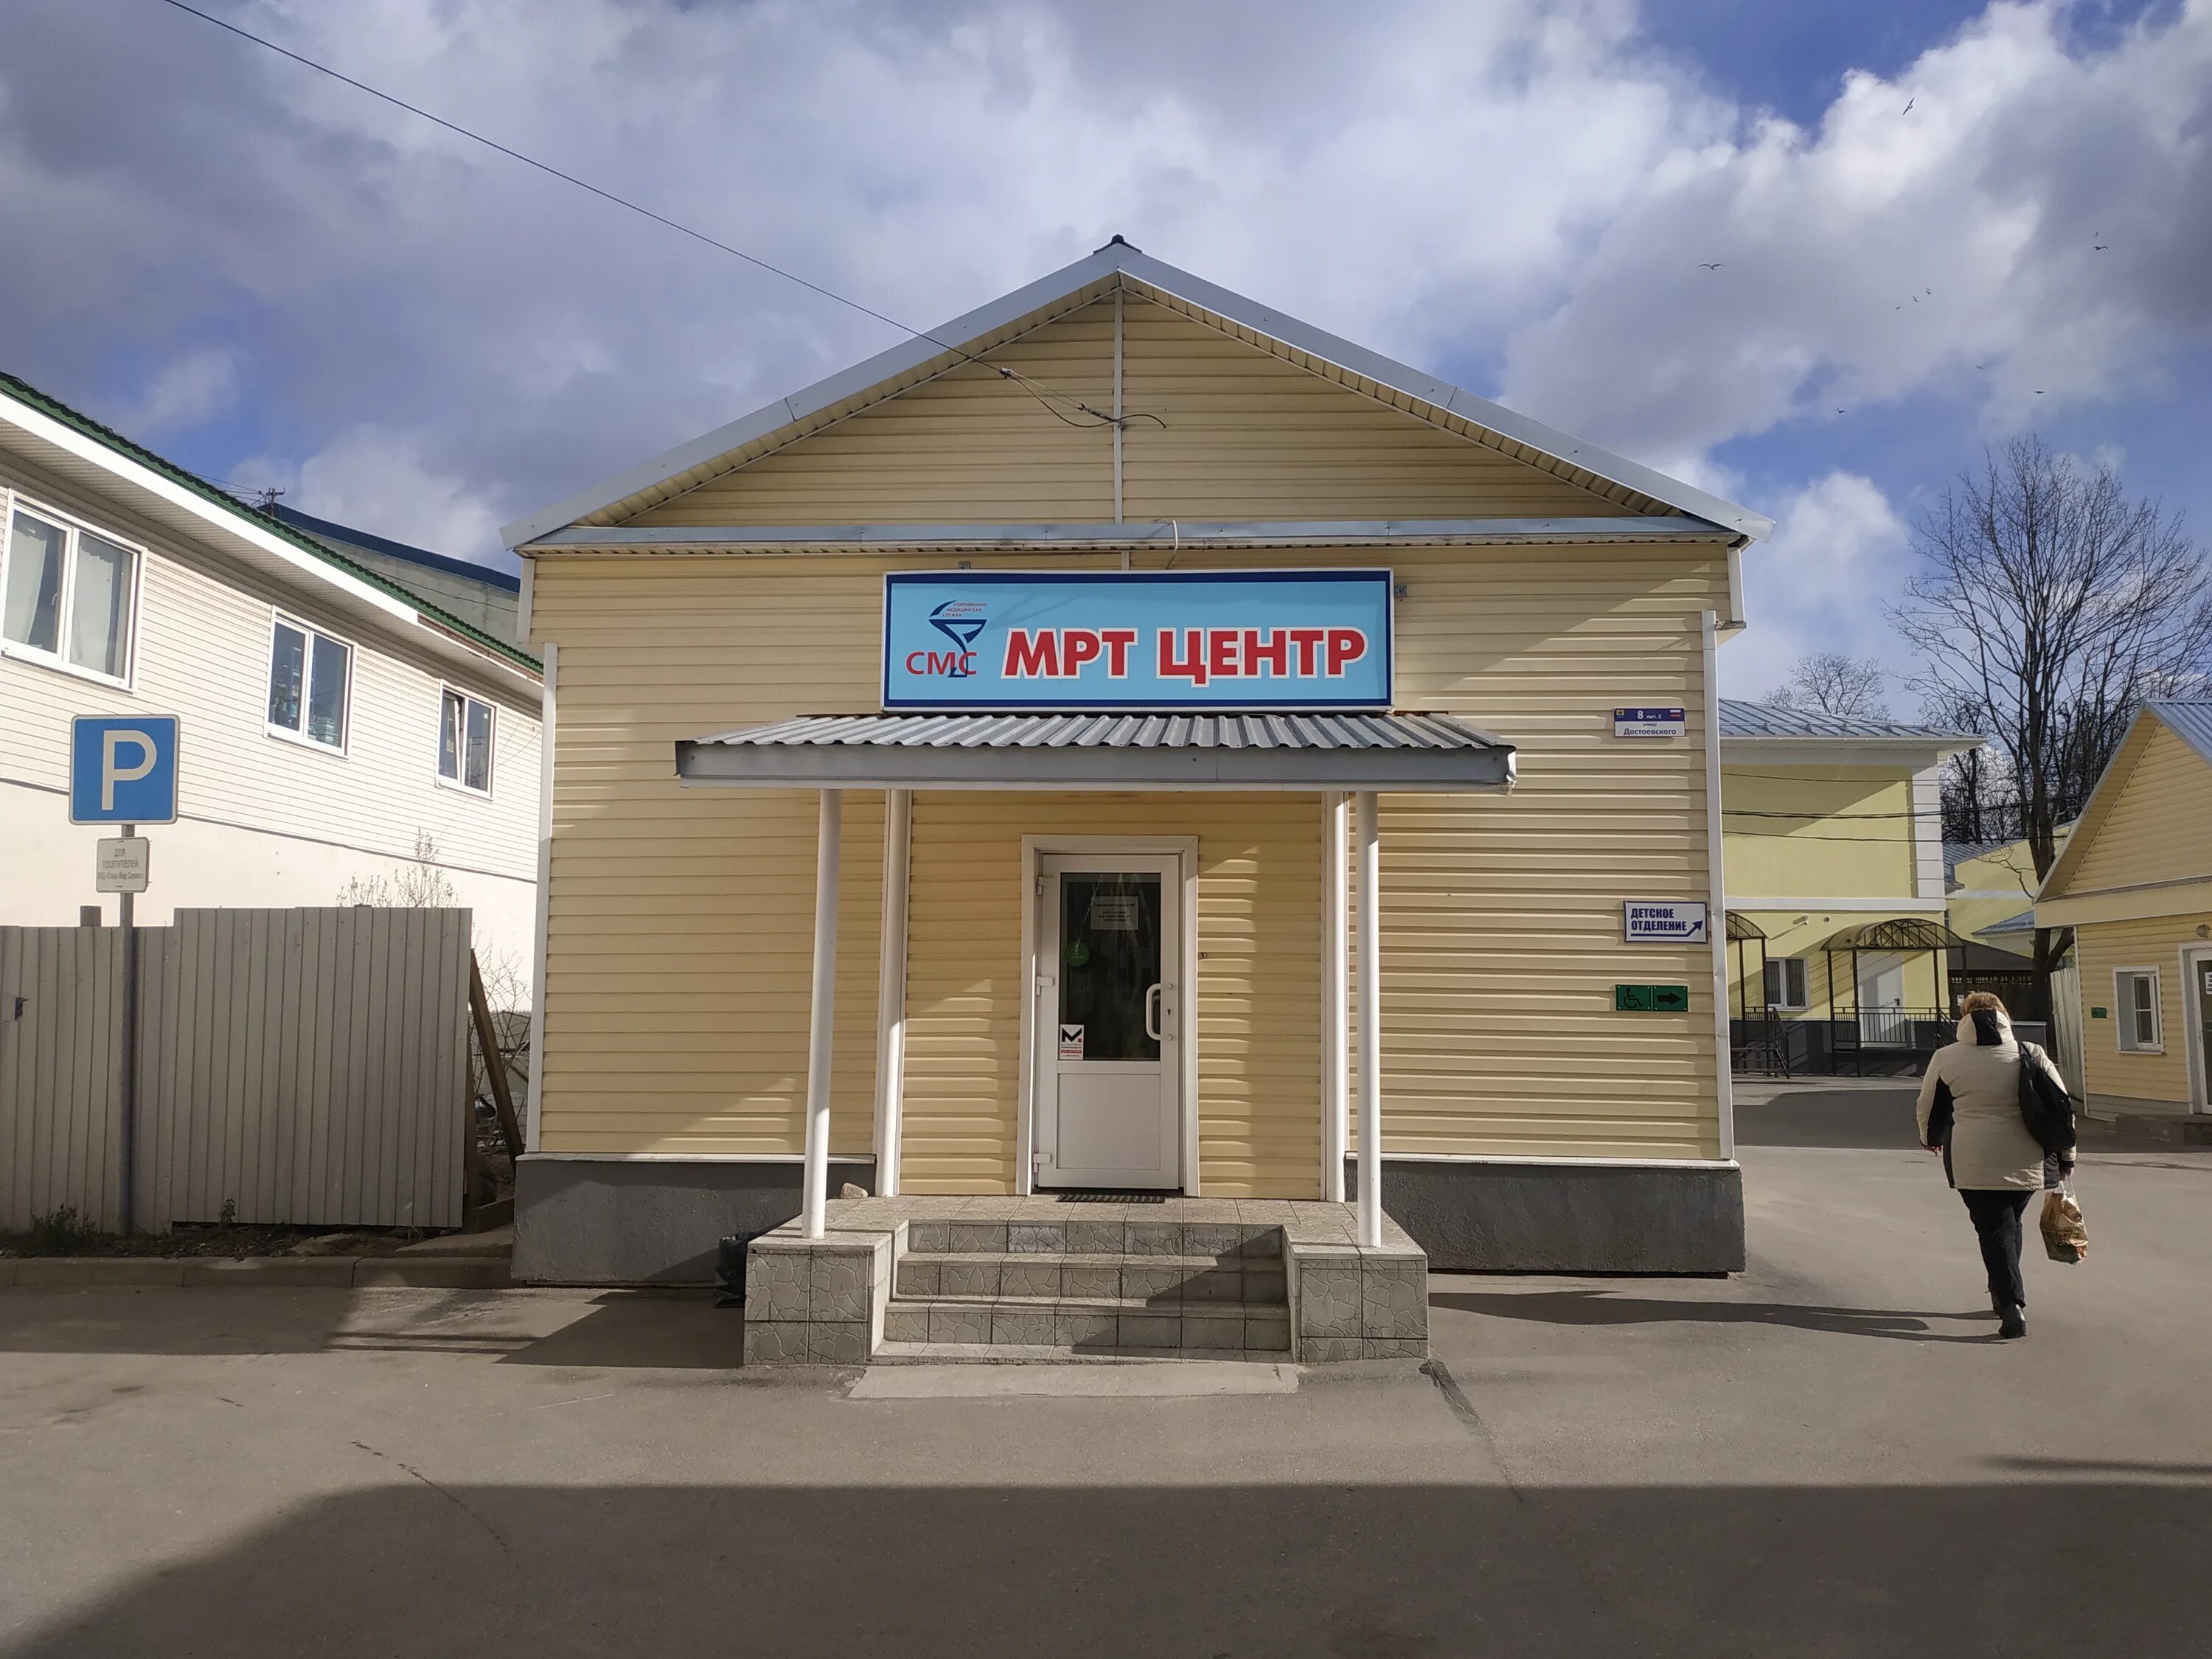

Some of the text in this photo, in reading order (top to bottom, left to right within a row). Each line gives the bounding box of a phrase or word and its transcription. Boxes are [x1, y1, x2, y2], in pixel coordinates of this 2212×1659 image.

[905, 651, 978, 675] СМС
[1002, 627, 1368, 686] МРТ ЦЕНТР
[1637, 711, 1644, 719] 8
[1623, 728, 1677, 736] Достоевского
[102, 730, 157, 810] P
[1630, 908, 1674, 919] ДЕТСКОЕ
[1631, 919, 1687, 932] ОТДЕЛЕНИЕ
